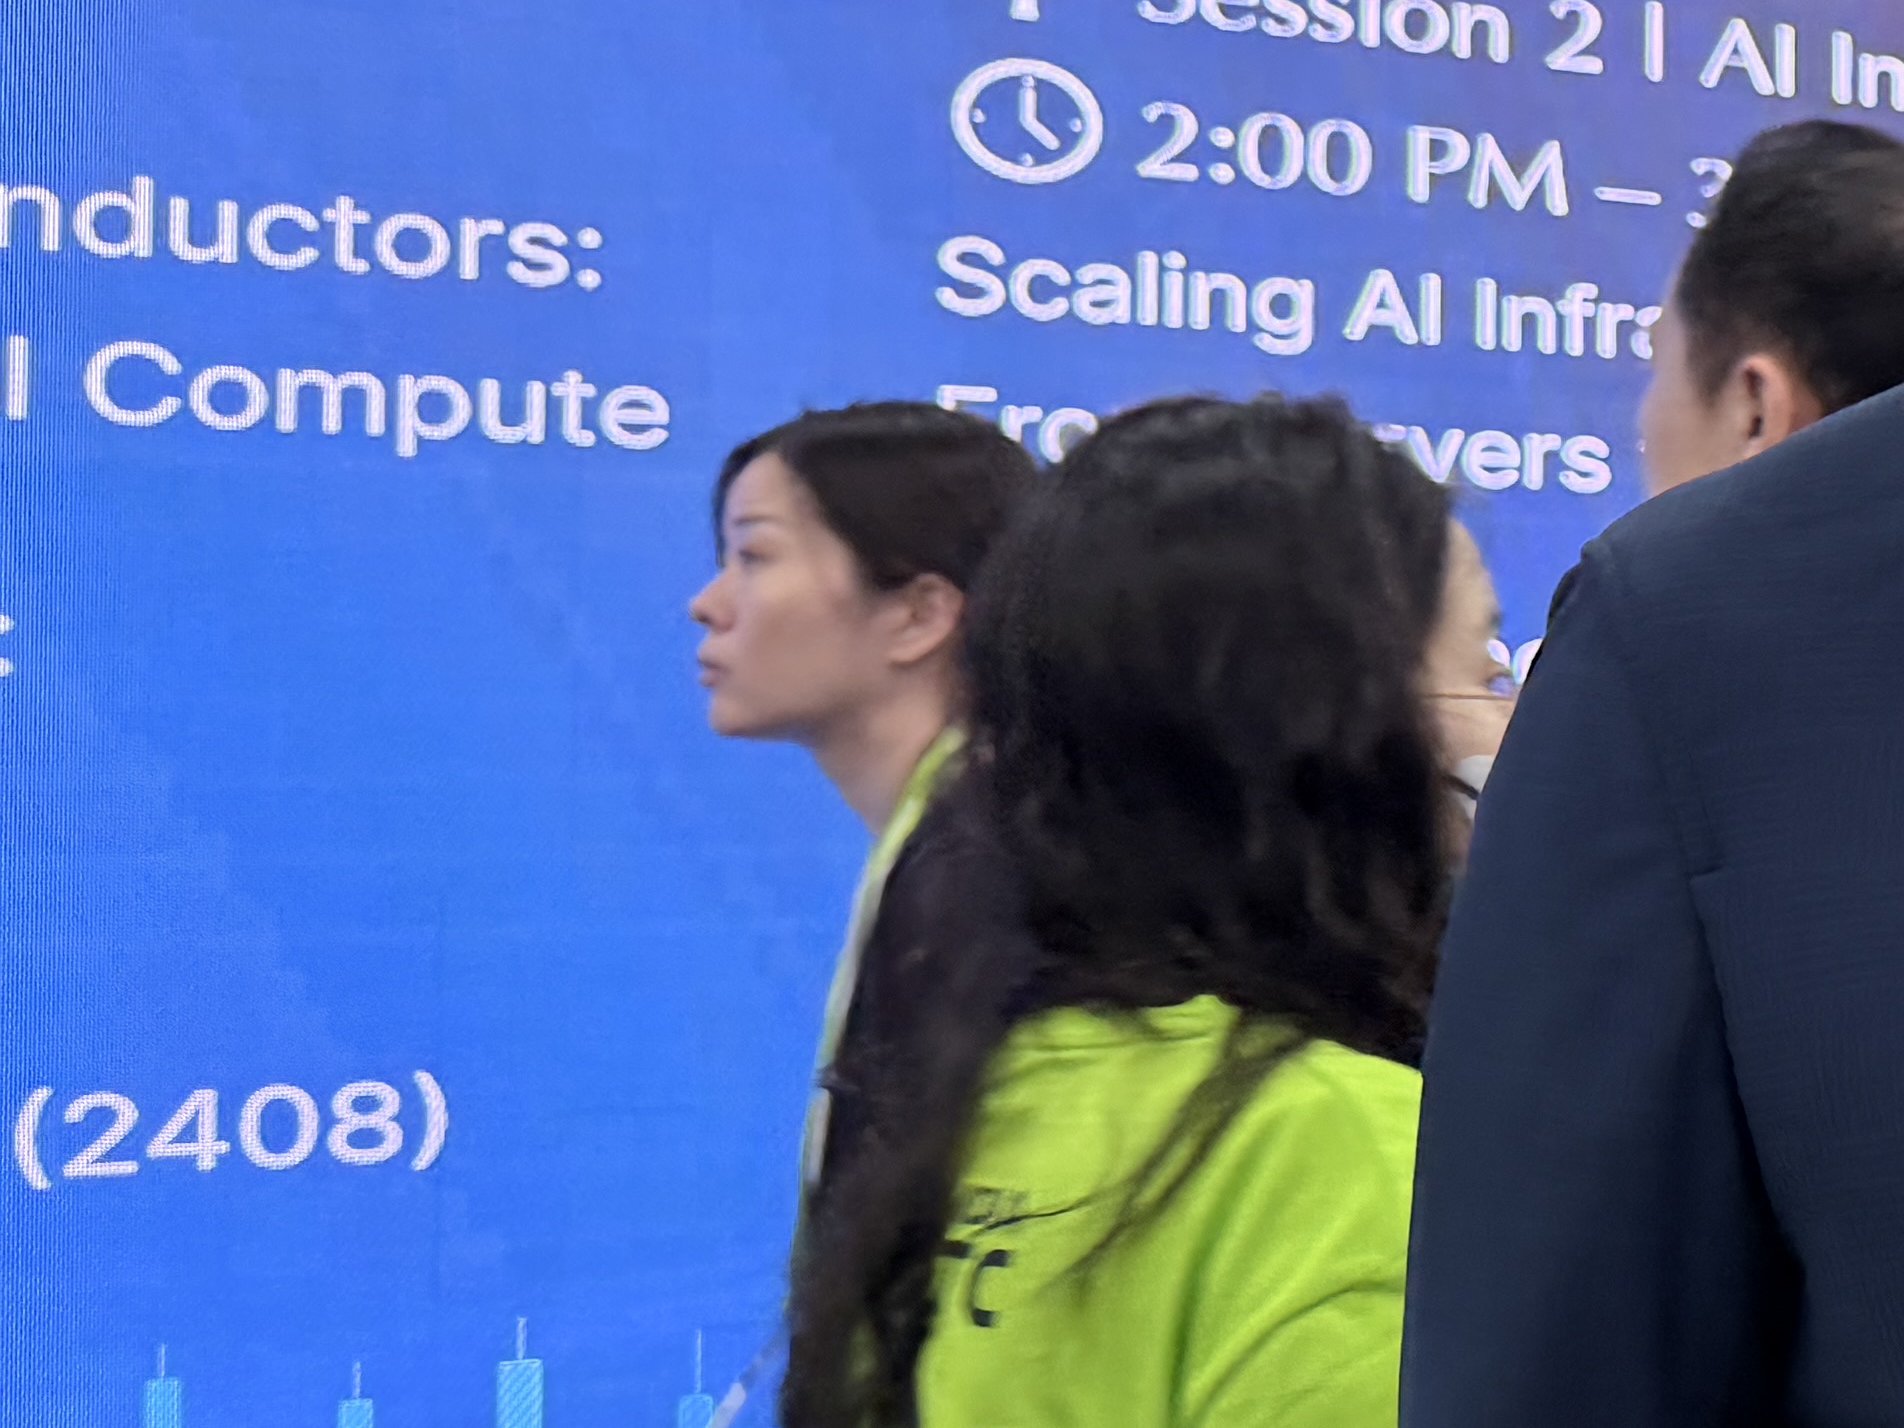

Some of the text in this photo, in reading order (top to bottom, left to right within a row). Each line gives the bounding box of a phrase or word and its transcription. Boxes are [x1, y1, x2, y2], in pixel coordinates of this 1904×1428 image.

[1701, 19, 1796, 99] AI
[1137, 101, 1373, 198] 2:00
[1406, 126, 1569, 217] PM
[0, 176, 602, 292] nductors:
[935, 236, 1315, 356] Scaling
[1345, 267, 1442, 347] AI
[84, 340, 669, 457] Compute
[15, 1070, 450, 1192] (2408)
